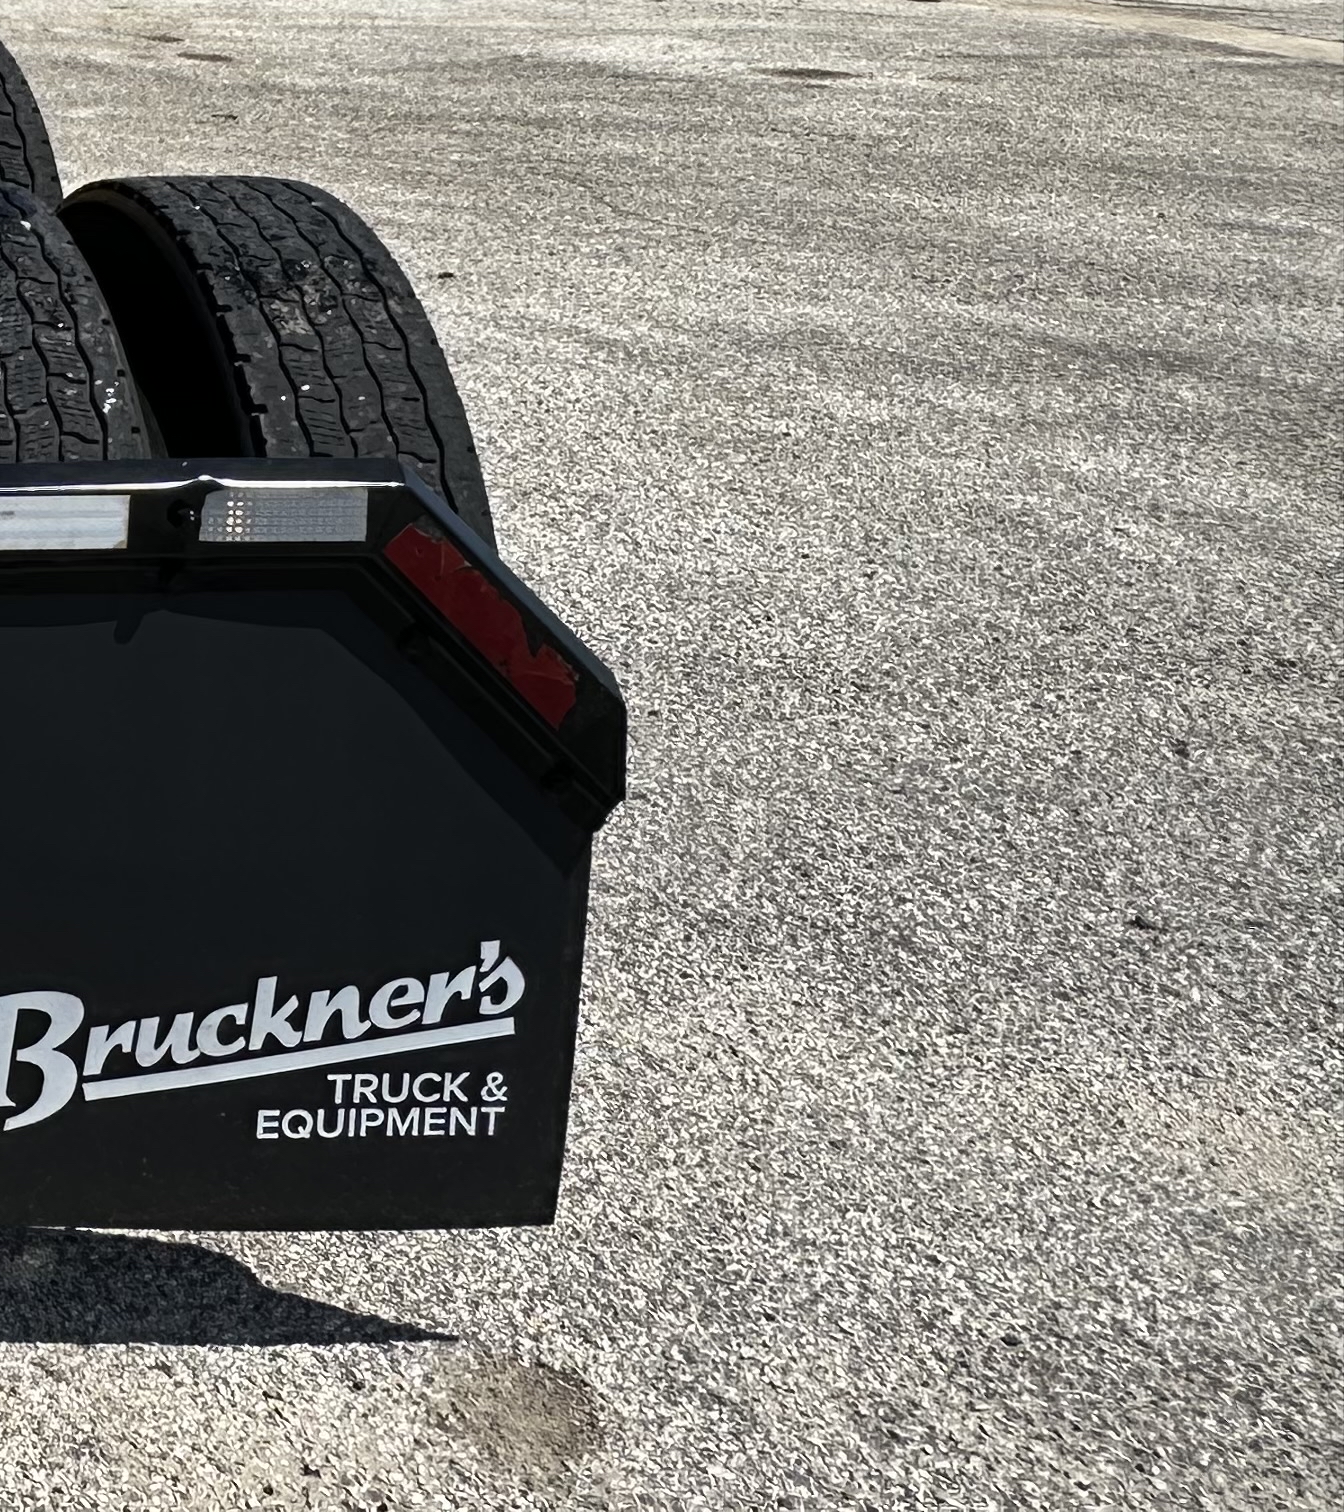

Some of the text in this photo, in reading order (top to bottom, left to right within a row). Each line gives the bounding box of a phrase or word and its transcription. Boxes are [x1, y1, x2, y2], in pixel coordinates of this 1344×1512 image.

[326, 1071, 508, 1105] TRUCK &
[256, 1106, 506, 1140] EQUIPMENT
